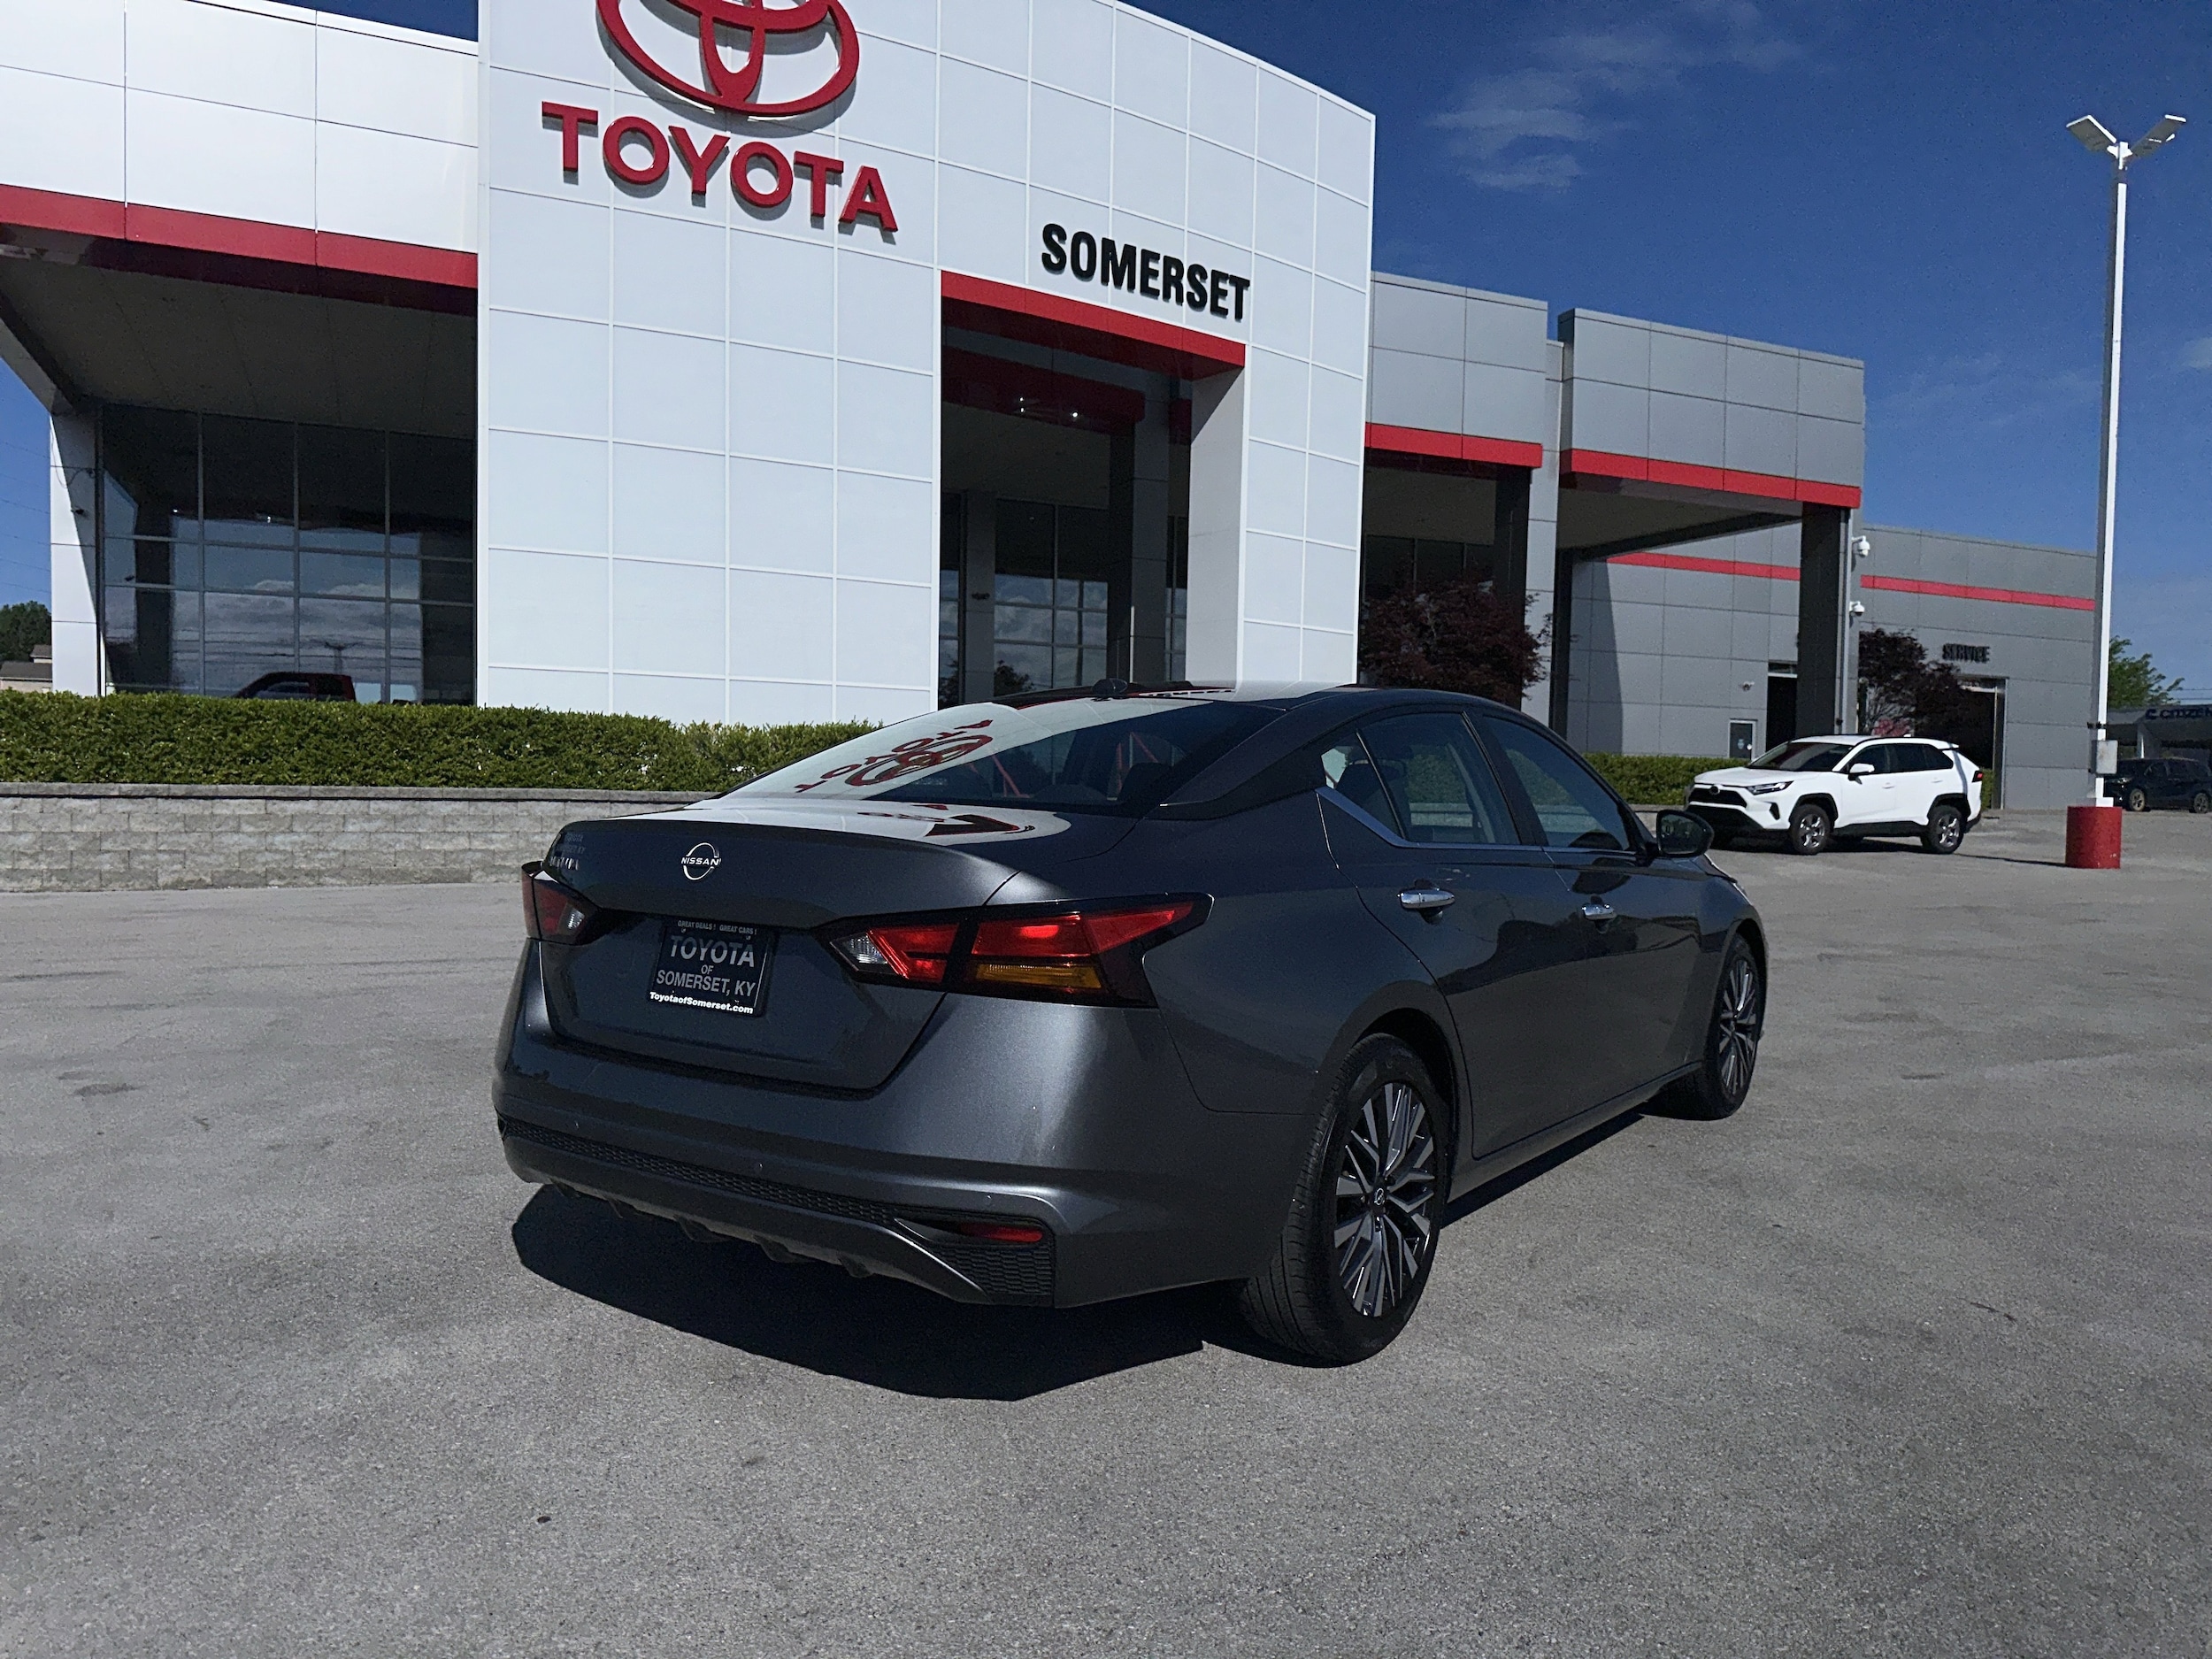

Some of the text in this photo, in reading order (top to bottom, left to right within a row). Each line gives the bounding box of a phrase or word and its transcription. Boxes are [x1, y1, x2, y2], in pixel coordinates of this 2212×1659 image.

[541, 101, 899, 233] TOYOTA
[1041, 223, 1250, 321] SOMERSET
[1942, 642, 1991, 664] SERVICE
[680, 856, 720, 866] NISSAN
[719, 924, 738, 933] GREAT
[671, 934, 755, 967] TOYOTA
[701, 964, 714, 974] OF
[656, 969, 757, 997] SOMERSET, KY
[649, 991, 755, 1015] ToyotaofSomerset.com
